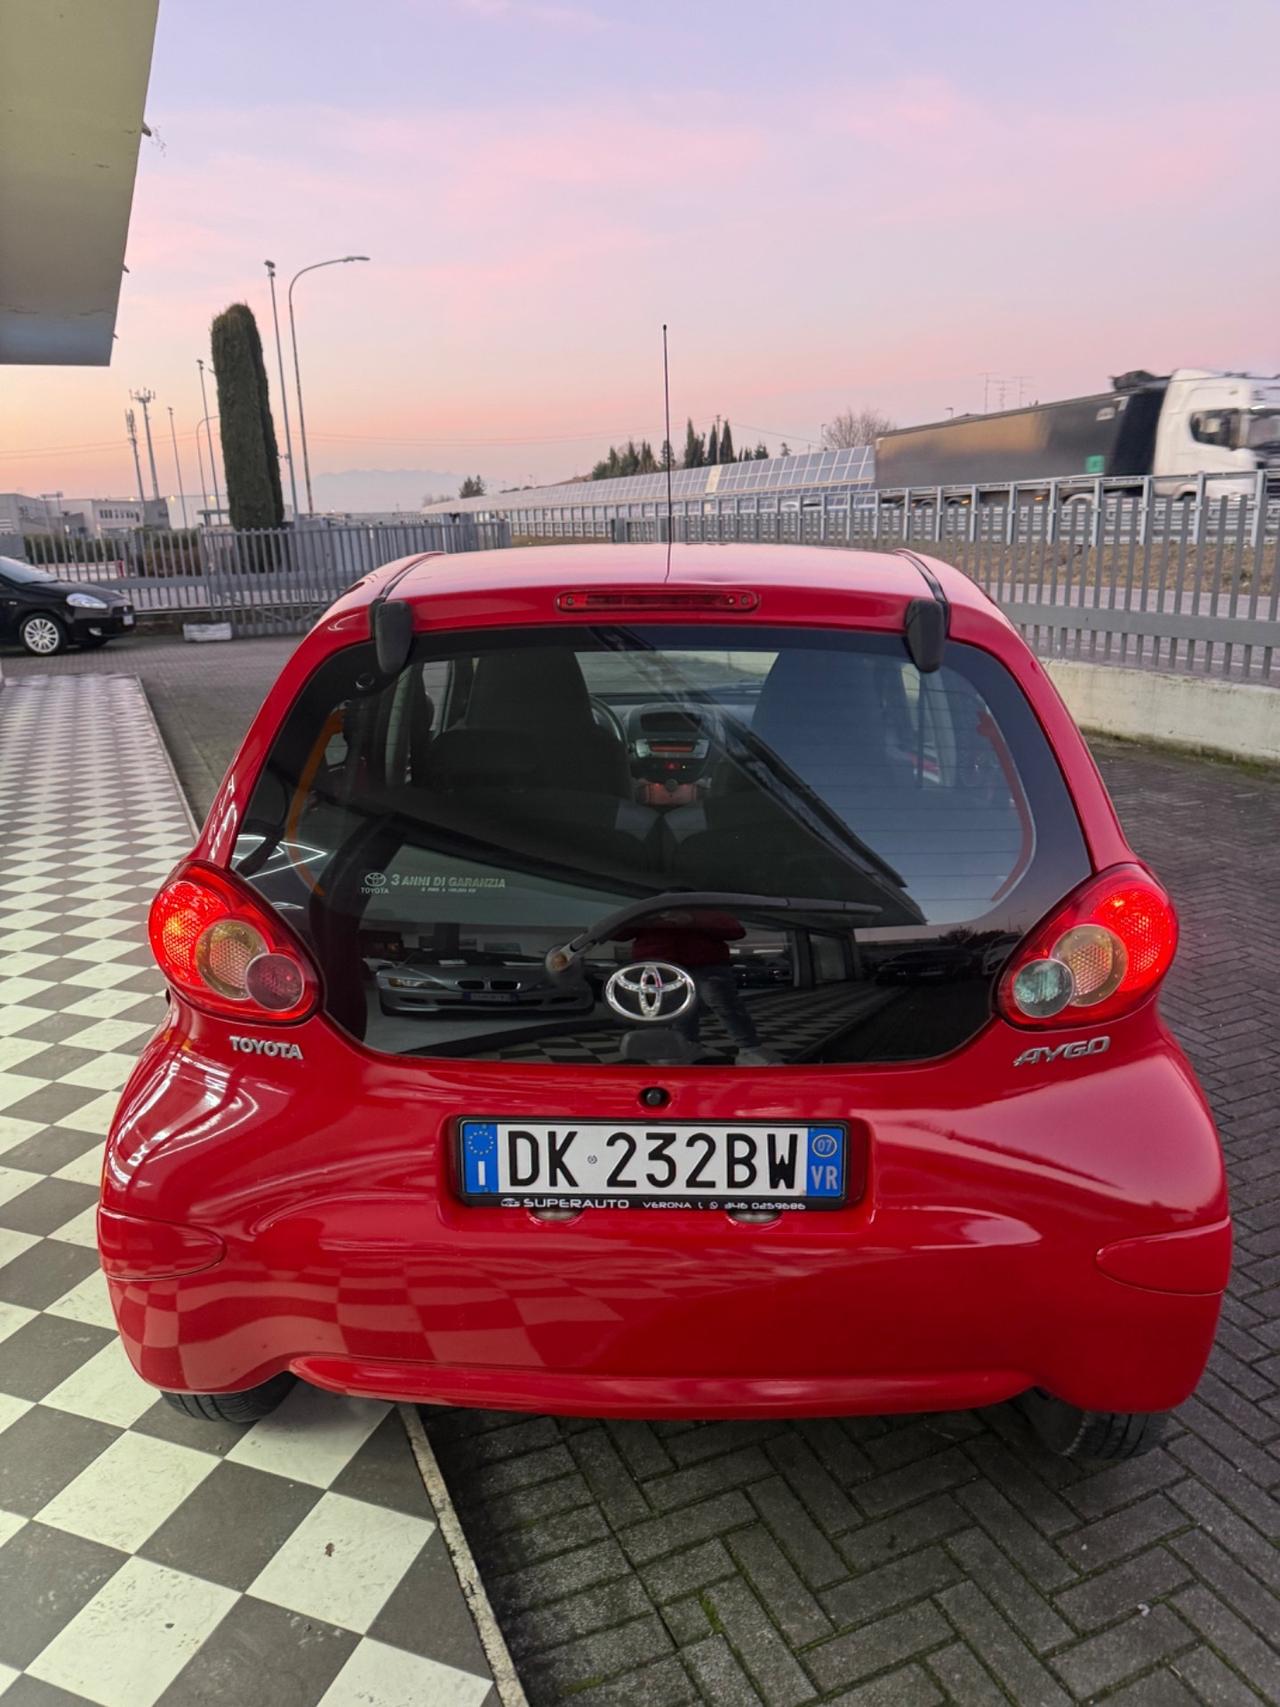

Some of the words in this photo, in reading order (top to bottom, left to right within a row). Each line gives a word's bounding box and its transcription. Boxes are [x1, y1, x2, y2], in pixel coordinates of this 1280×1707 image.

[391, 874, 400, 886] 3
[401, 876, 431, 887] ANNI
[432, 877, 446, 887] DI
[448, 877, 506, 888] GARANZIA
[229, 1034, 304, 1060] TOYOTA
[1013, 1035, 1110, 1067] AYGO
[817, 1139, 833, 1153] 07
[508, 1130, 579, 1188] DK
[606, 1132, 799, 1190] 232BW
[478, 1161, 486, 1186] I
[811, 1165, 838, 1190] VR
[523, 1198, 629, 1209] SUPERAUTO
[643, 1201, 692, 1209] VERONA
